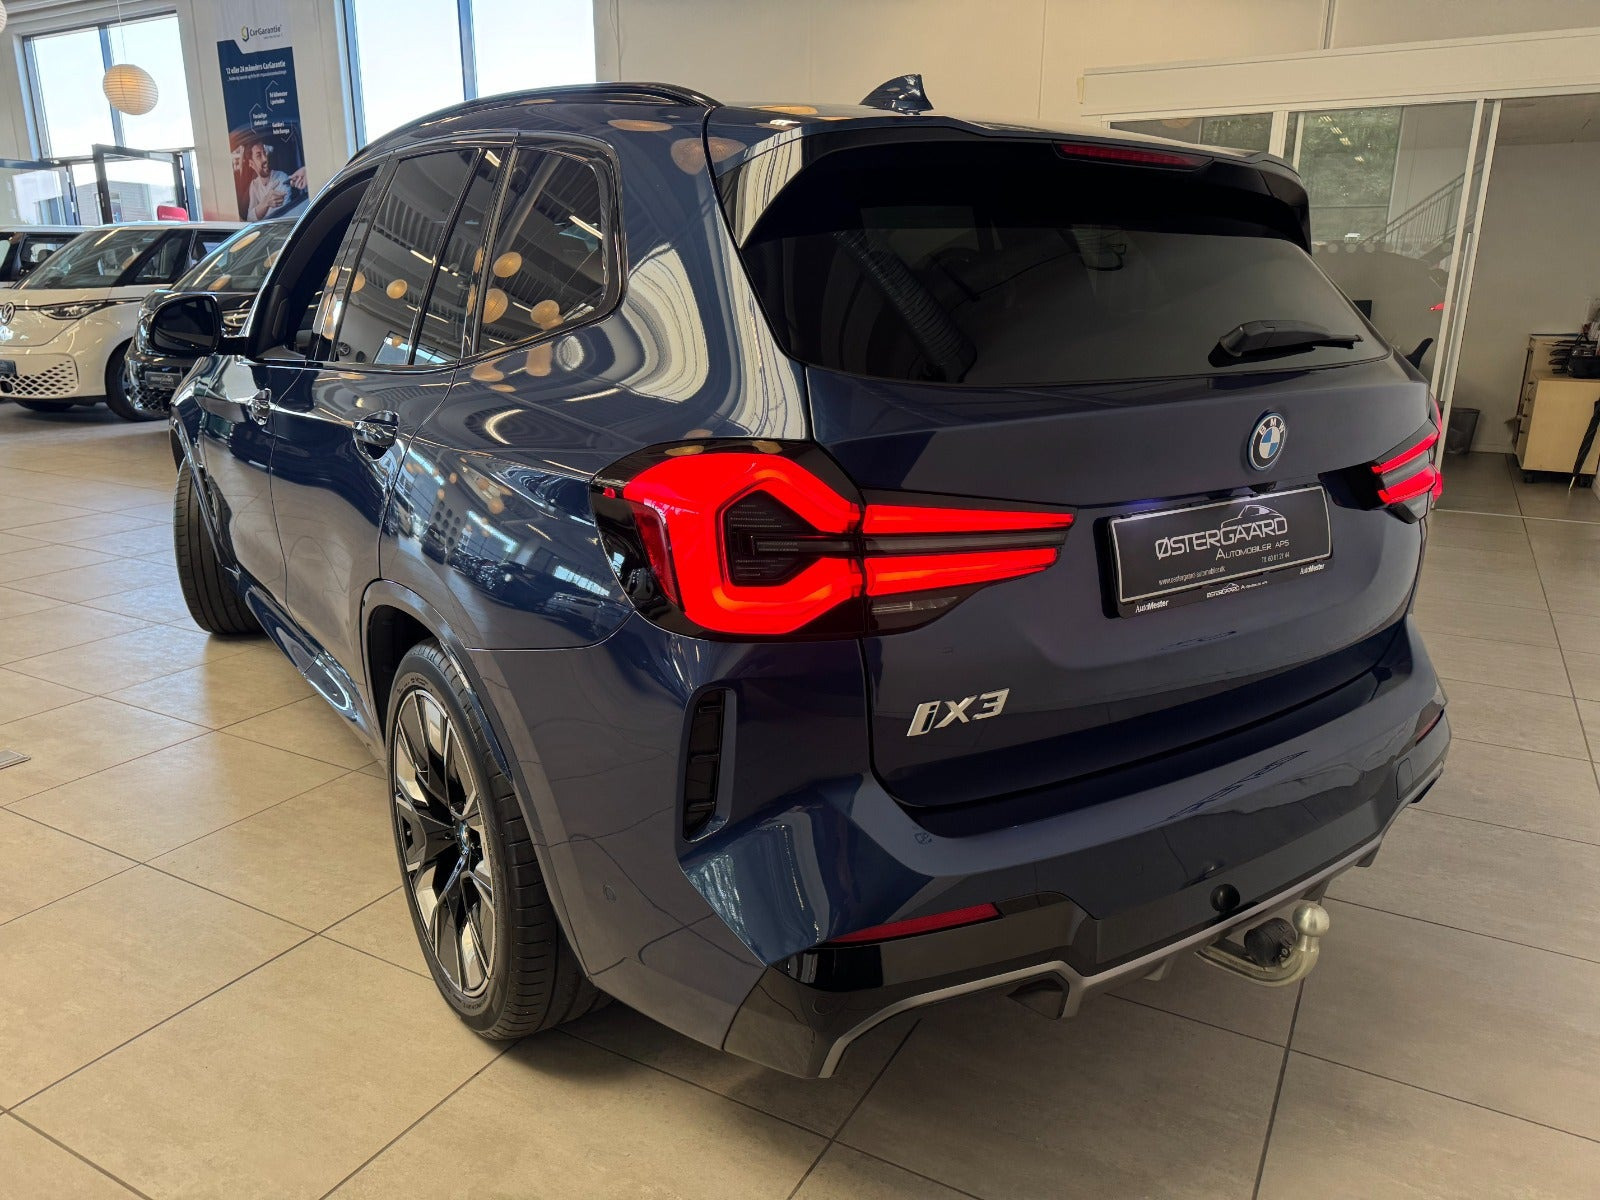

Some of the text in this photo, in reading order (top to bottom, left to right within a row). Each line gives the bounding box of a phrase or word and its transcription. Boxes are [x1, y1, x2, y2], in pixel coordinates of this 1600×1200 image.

[1259, 417, 1285, 436] BMW
[1155, 518, 1288, 560] ØSTERGAARD
[1135, 600, 1169, 613] AutoMester
[907, 688, 1010, 736] iX3
